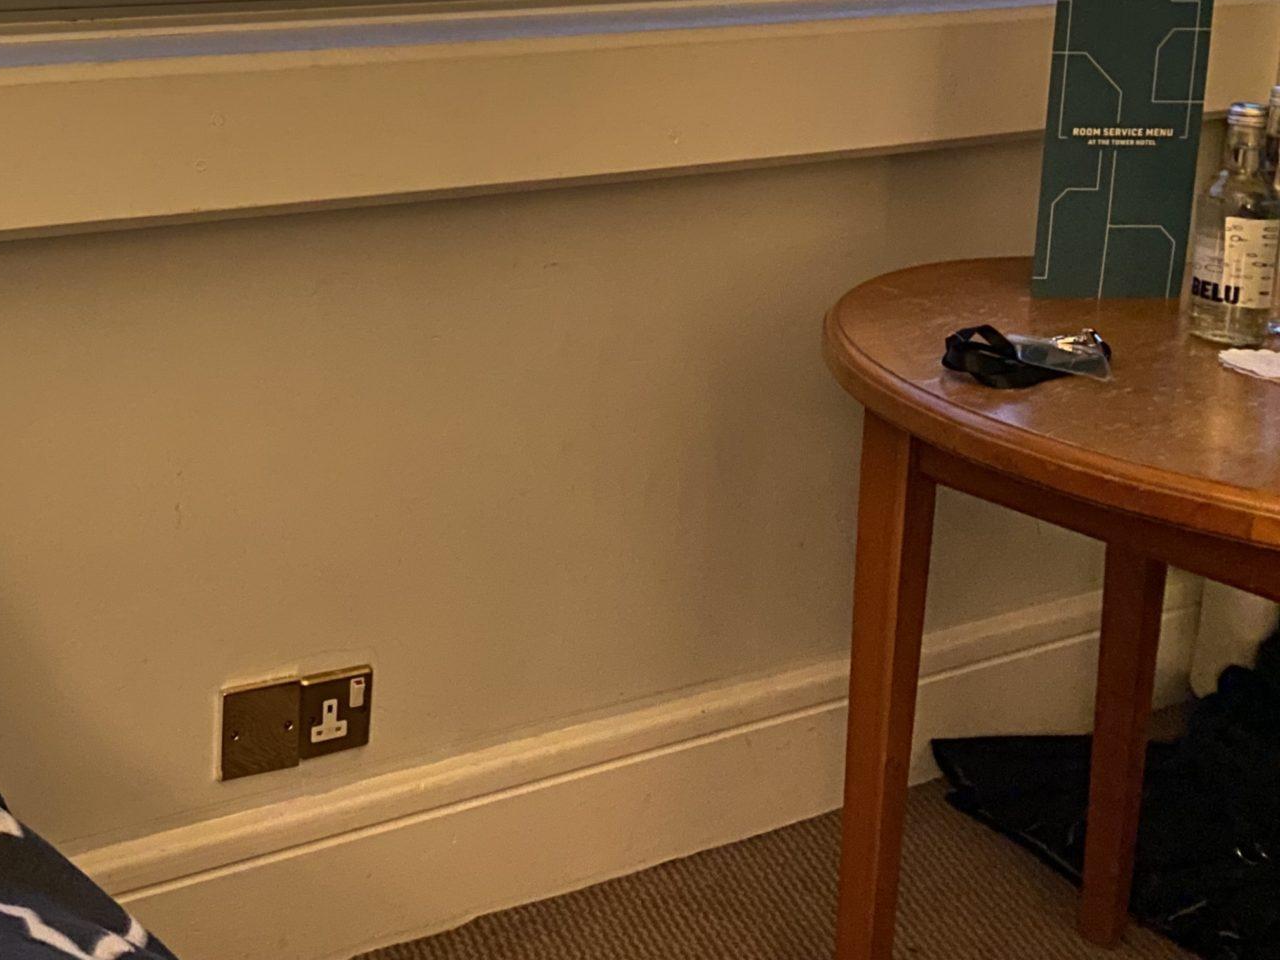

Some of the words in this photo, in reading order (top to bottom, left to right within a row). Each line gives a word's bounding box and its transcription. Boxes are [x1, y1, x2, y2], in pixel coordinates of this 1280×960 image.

[1072, 127, 1101, 136] ROOM
[1103, 127, 1144, 137] SERVICE
[1145, 127, 1174, 137] MENU
[1191, 276, 1241, 305] BELU
